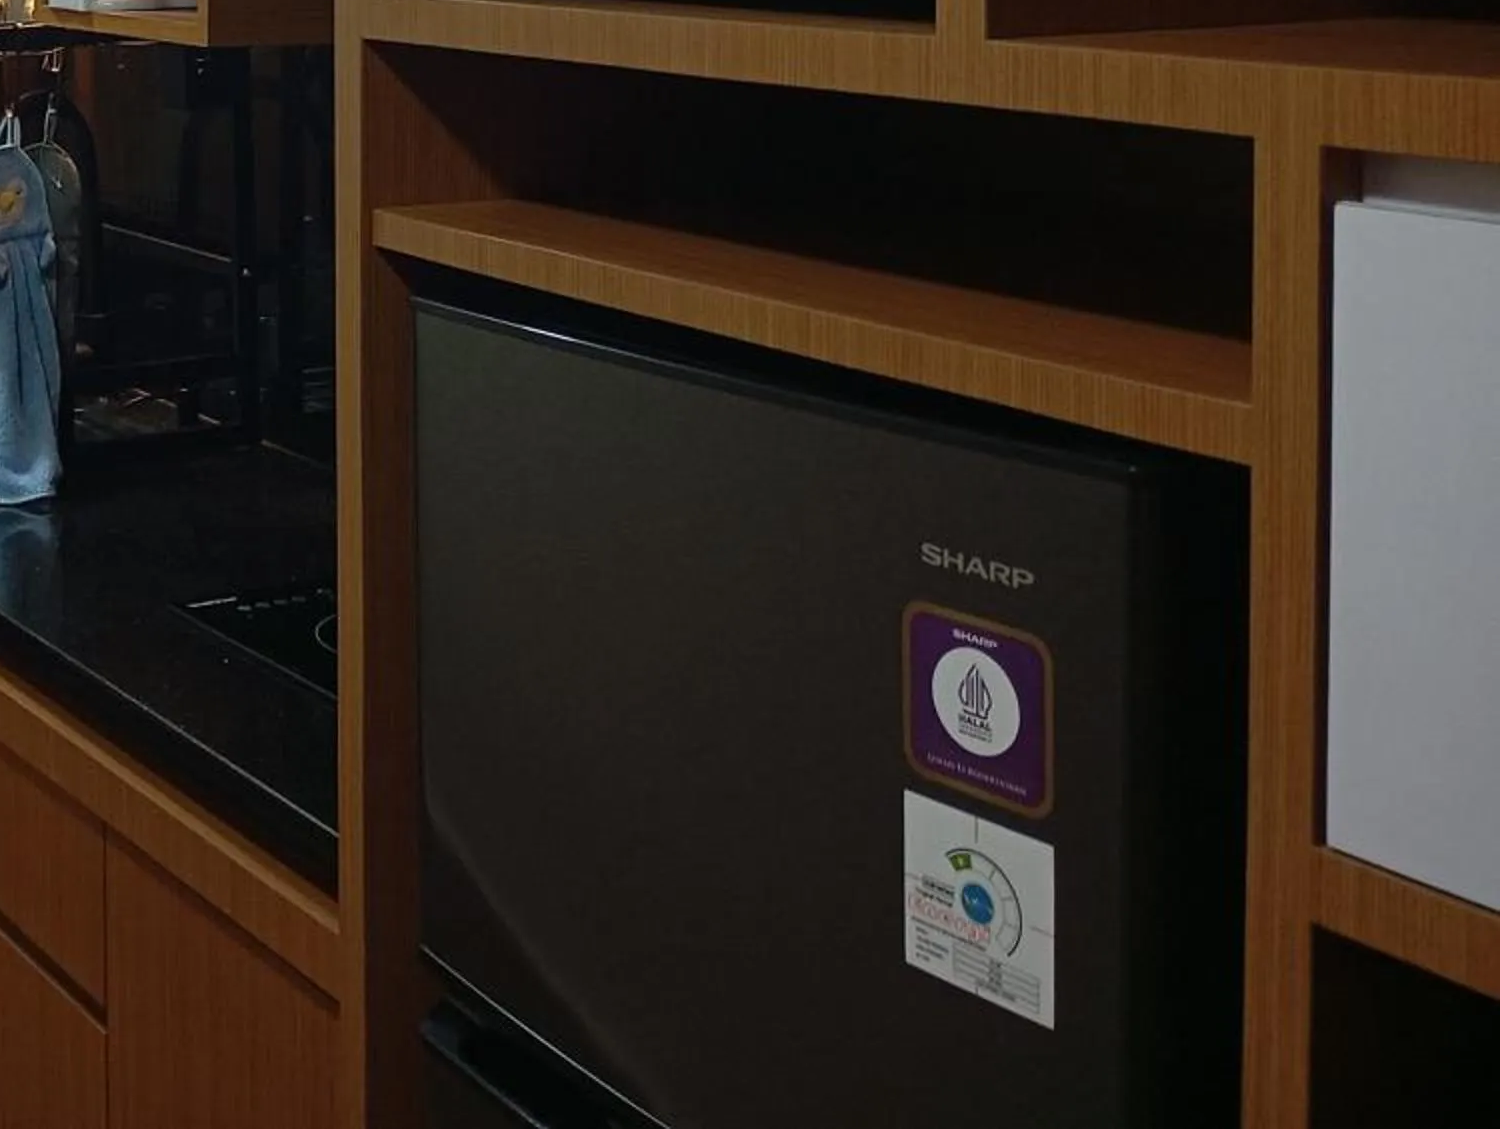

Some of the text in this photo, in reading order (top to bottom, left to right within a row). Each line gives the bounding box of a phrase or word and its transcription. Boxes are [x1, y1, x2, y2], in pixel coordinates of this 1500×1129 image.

[921, 542, 1035, 589] SHARP
[952, 628, 998, 648] SHARP
[957, 712, 992, 731] HALAL
